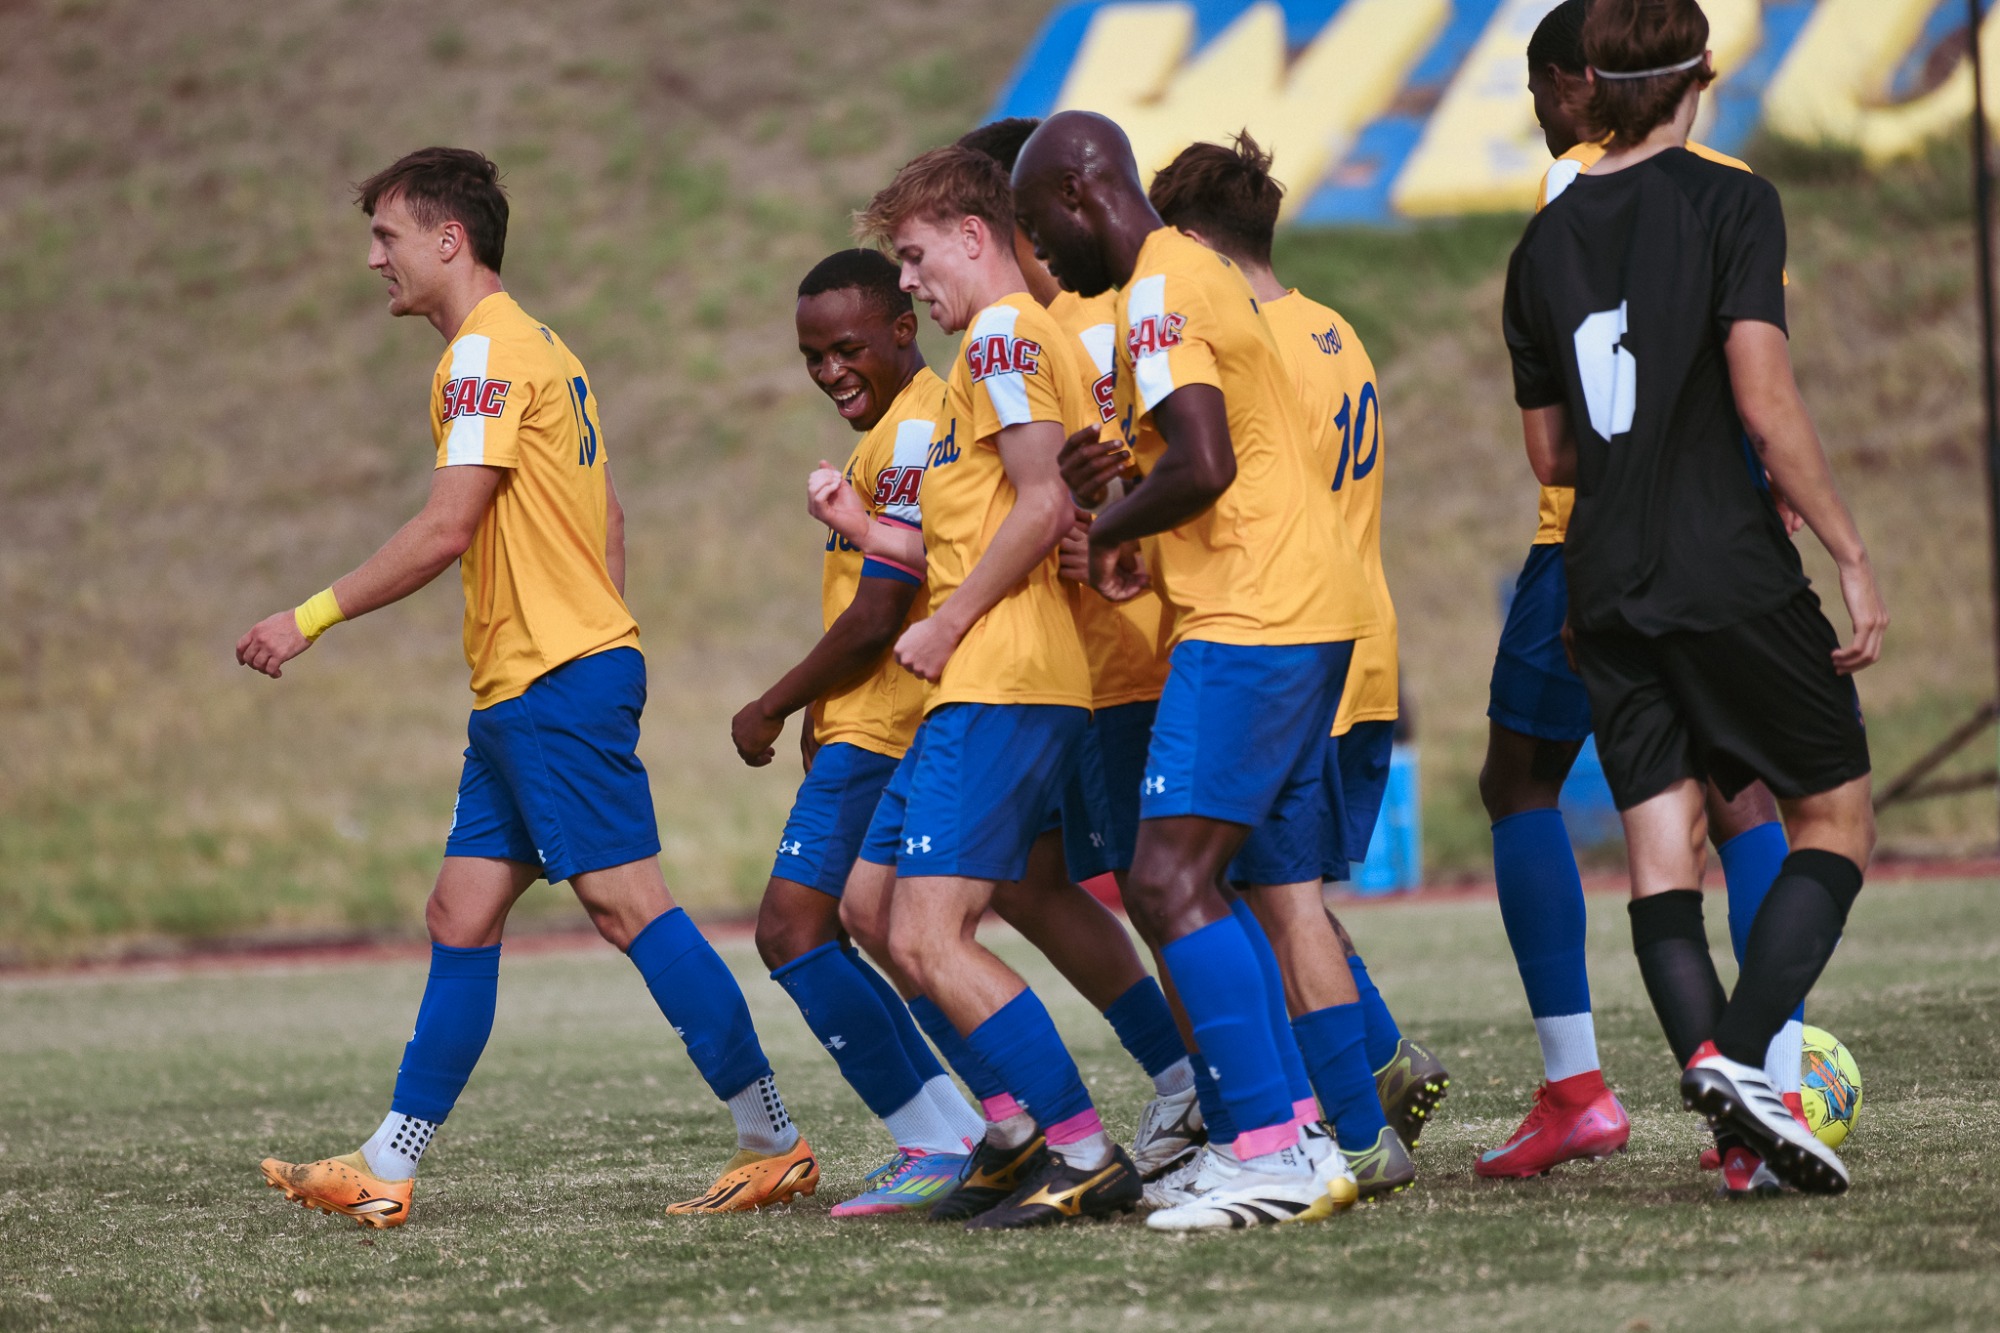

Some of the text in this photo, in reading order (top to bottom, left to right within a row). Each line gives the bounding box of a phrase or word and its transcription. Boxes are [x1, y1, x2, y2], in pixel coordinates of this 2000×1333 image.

[965, 333, 1041, 384] SAC
[1126, 312, 1188, 371] SAC
[442, 377, 511, 424] SAC
[1331, 381, 1378, 492] 10
[874, 466, 925, 506] SA
